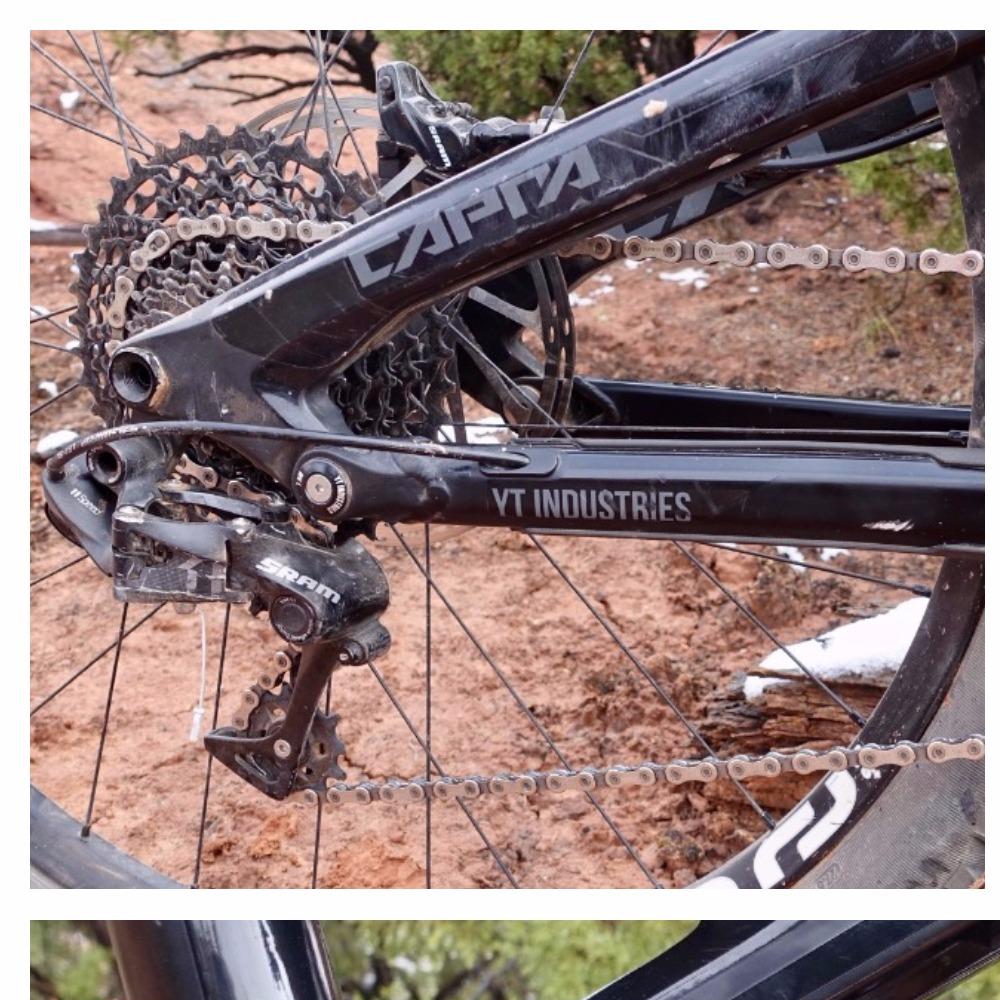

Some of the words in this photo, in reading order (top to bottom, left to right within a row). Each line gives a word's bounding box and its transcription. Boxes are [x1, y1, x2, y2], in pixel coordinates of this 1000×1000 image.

[350, 145, 601, 288] CAPRA
[492, 487, 526, 518] YT
[533, 488, 692, 523] INDUSTRIES
[255, 557, 342, 605] SRAM
